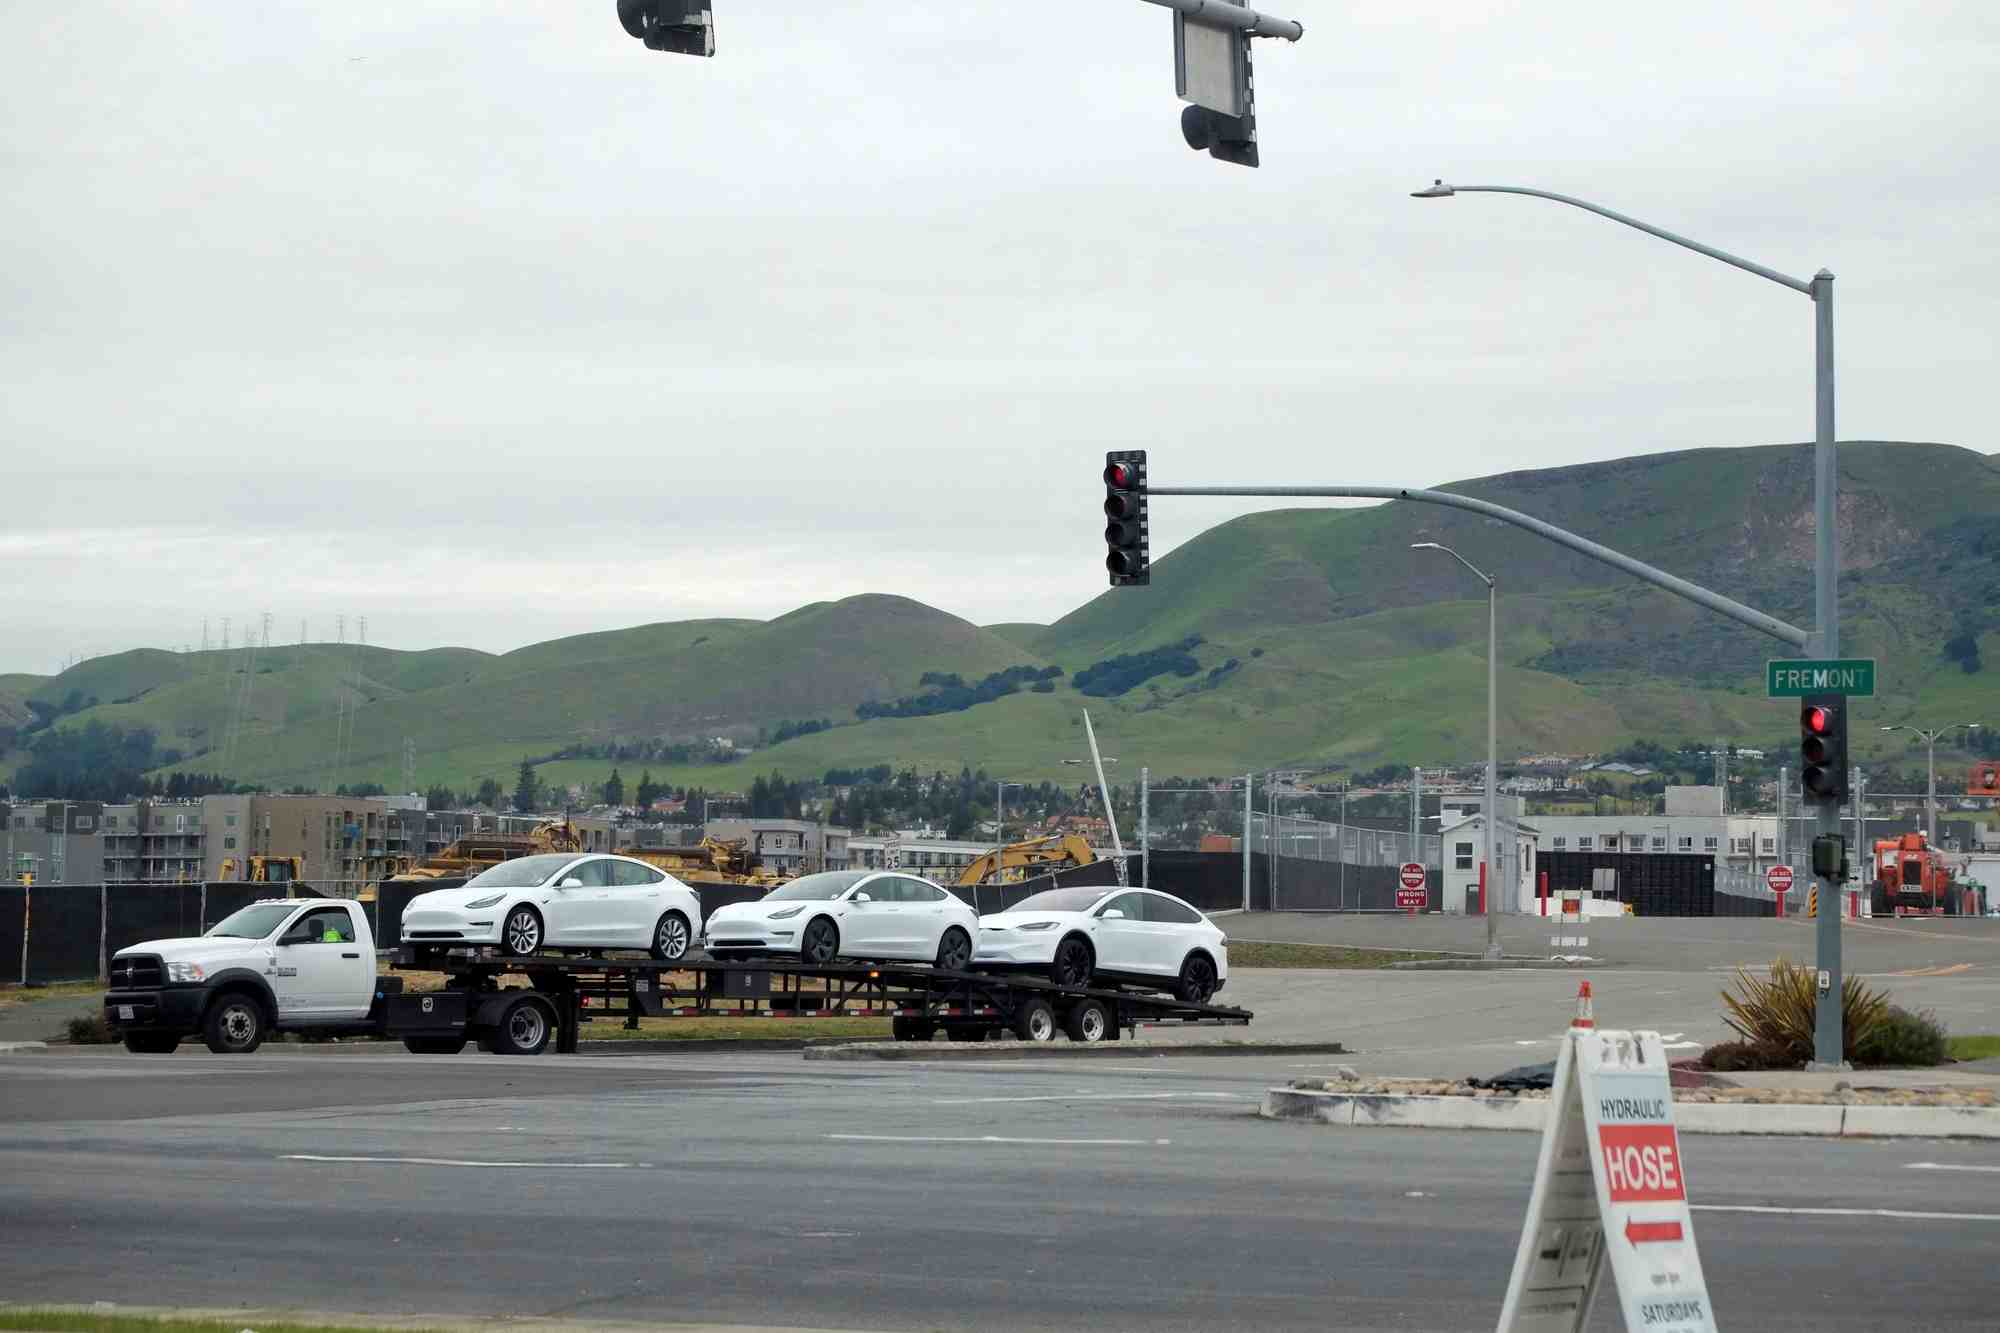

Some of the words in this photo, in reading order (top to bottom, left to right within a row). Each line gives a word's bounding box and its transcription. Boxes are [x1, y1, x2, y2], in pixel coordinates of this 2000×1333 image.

[1775, 669, 1866, 689] FREMONT
[1601, 1099, 1665, 1119] HYDRAULIC
[1606, 1146, 1677, 1191] HOSE
[1641, 1301, 1703, 1324] SATURDAYS
